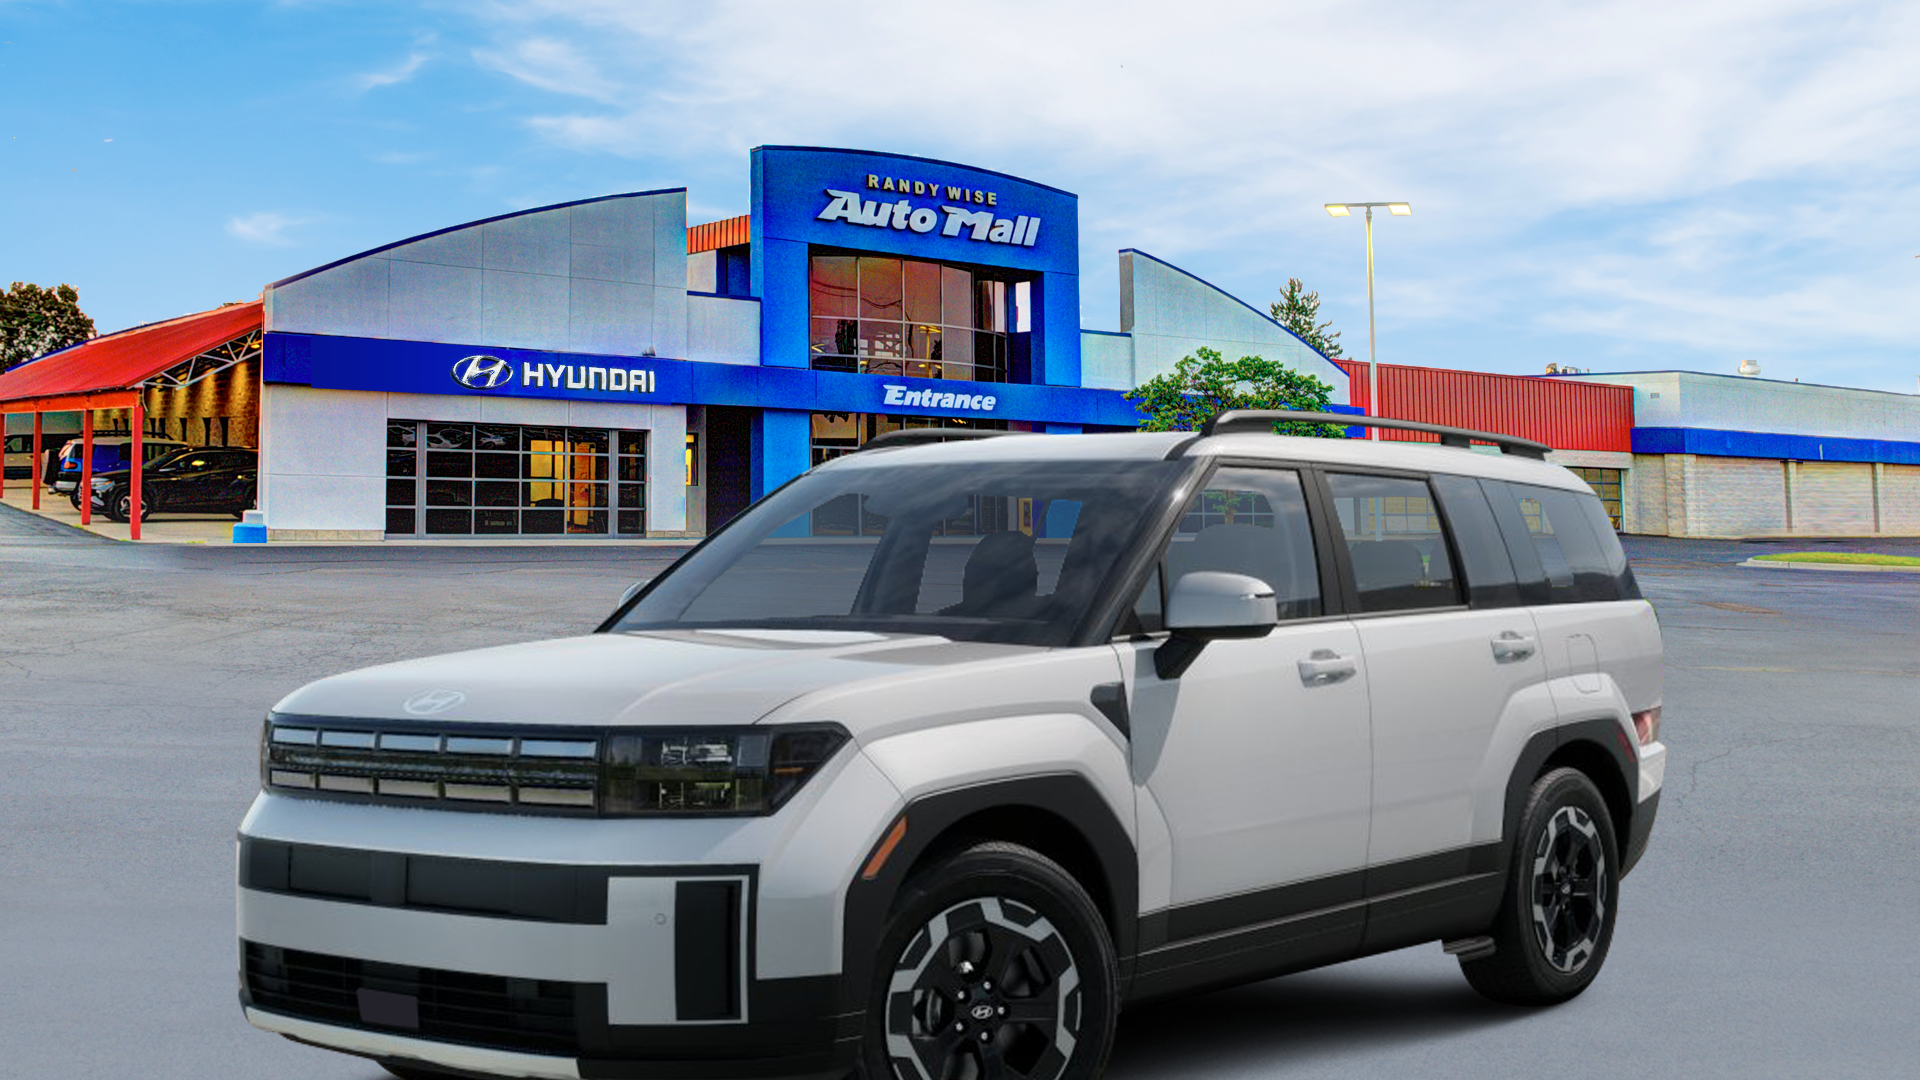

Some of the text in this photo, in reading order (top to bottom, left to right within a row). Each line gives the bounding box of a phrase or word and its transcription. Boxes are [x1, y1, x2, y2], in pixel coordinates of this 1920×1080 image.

[866, 173, 997, 206] RANDY WISE
[819, 188, 1041, 246] Auto Mall
[522, 361, 655, 393] HYUNDAI
[883, 384, 996, 411] Entrance
